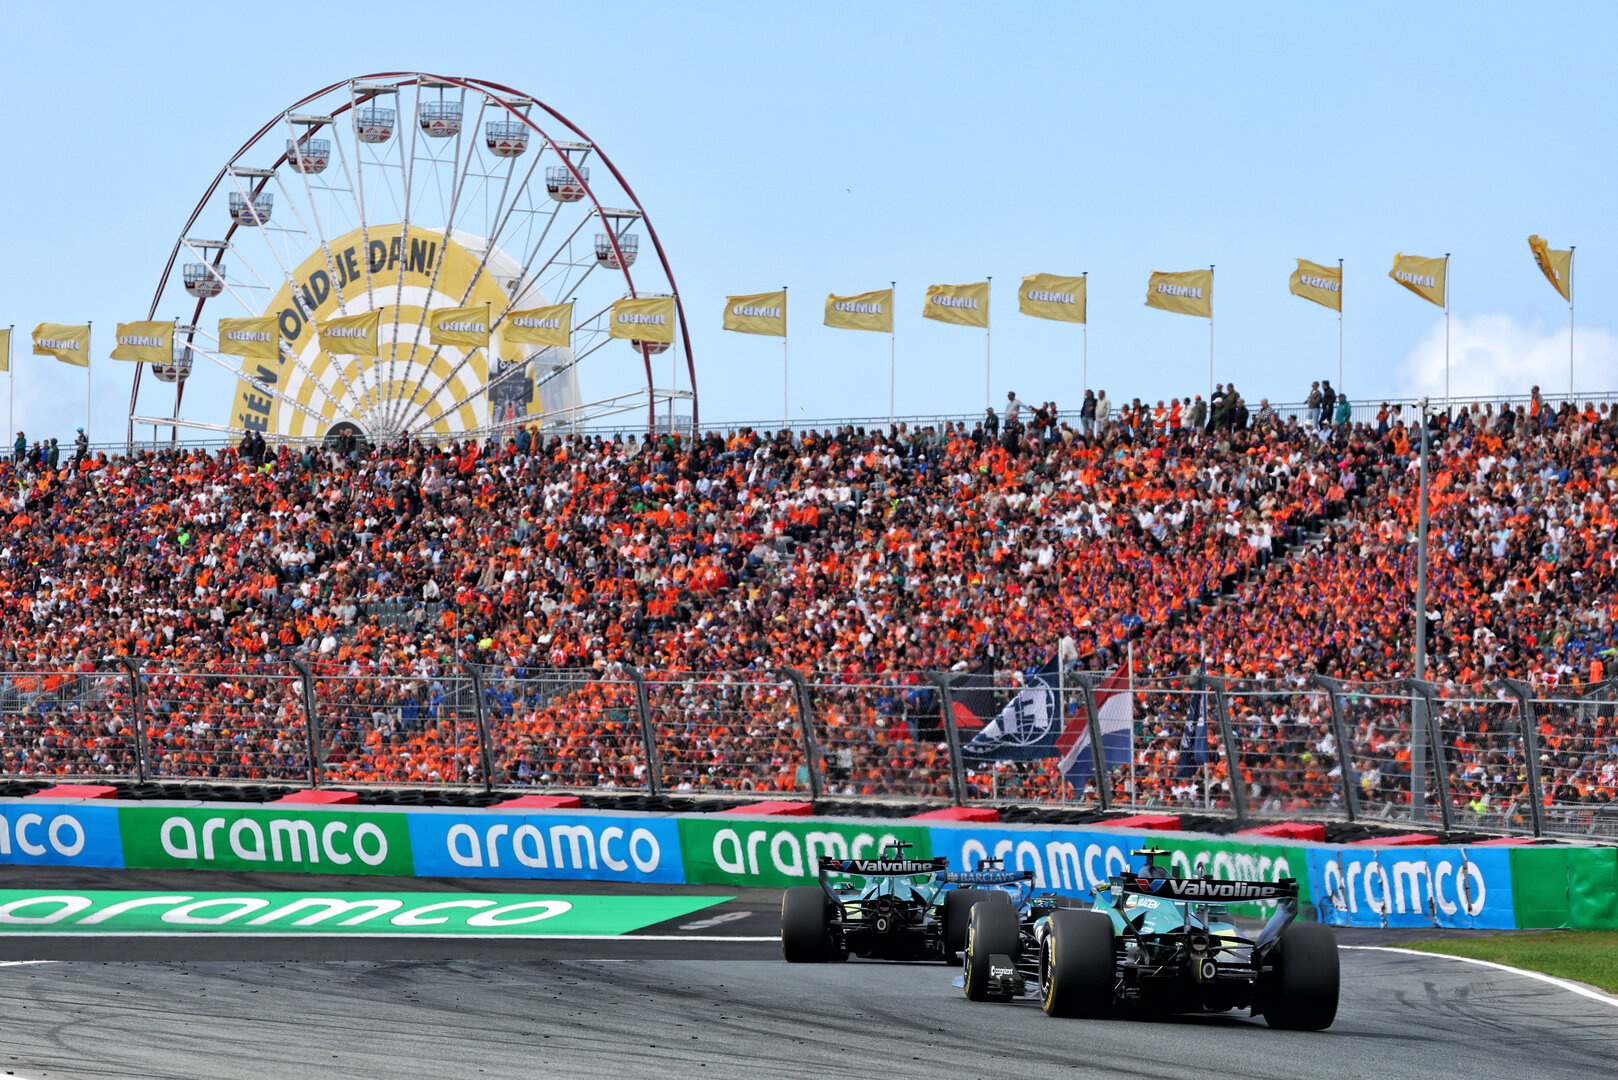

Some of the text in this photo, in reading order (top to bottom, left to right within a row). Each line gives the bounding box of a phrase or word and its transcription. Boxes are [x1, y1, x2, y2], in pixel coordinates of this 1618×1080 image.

[278, 247, 361, 365] ONDJE
[368, 236, 437, 277] DAN!
[0, 813, 85, 857] co
[160, 816, 388, 866] aramco
[446, 823, 661, 873] aramco
[855, 860, 933, 873] Valvoline
[960, 872, 1015, 882] BARCLAYS
[1169, 879, 1276, 898] Valvoline
[1324, 859, 1486, 917] aramco
[0, 895, 573, 927] aramco
